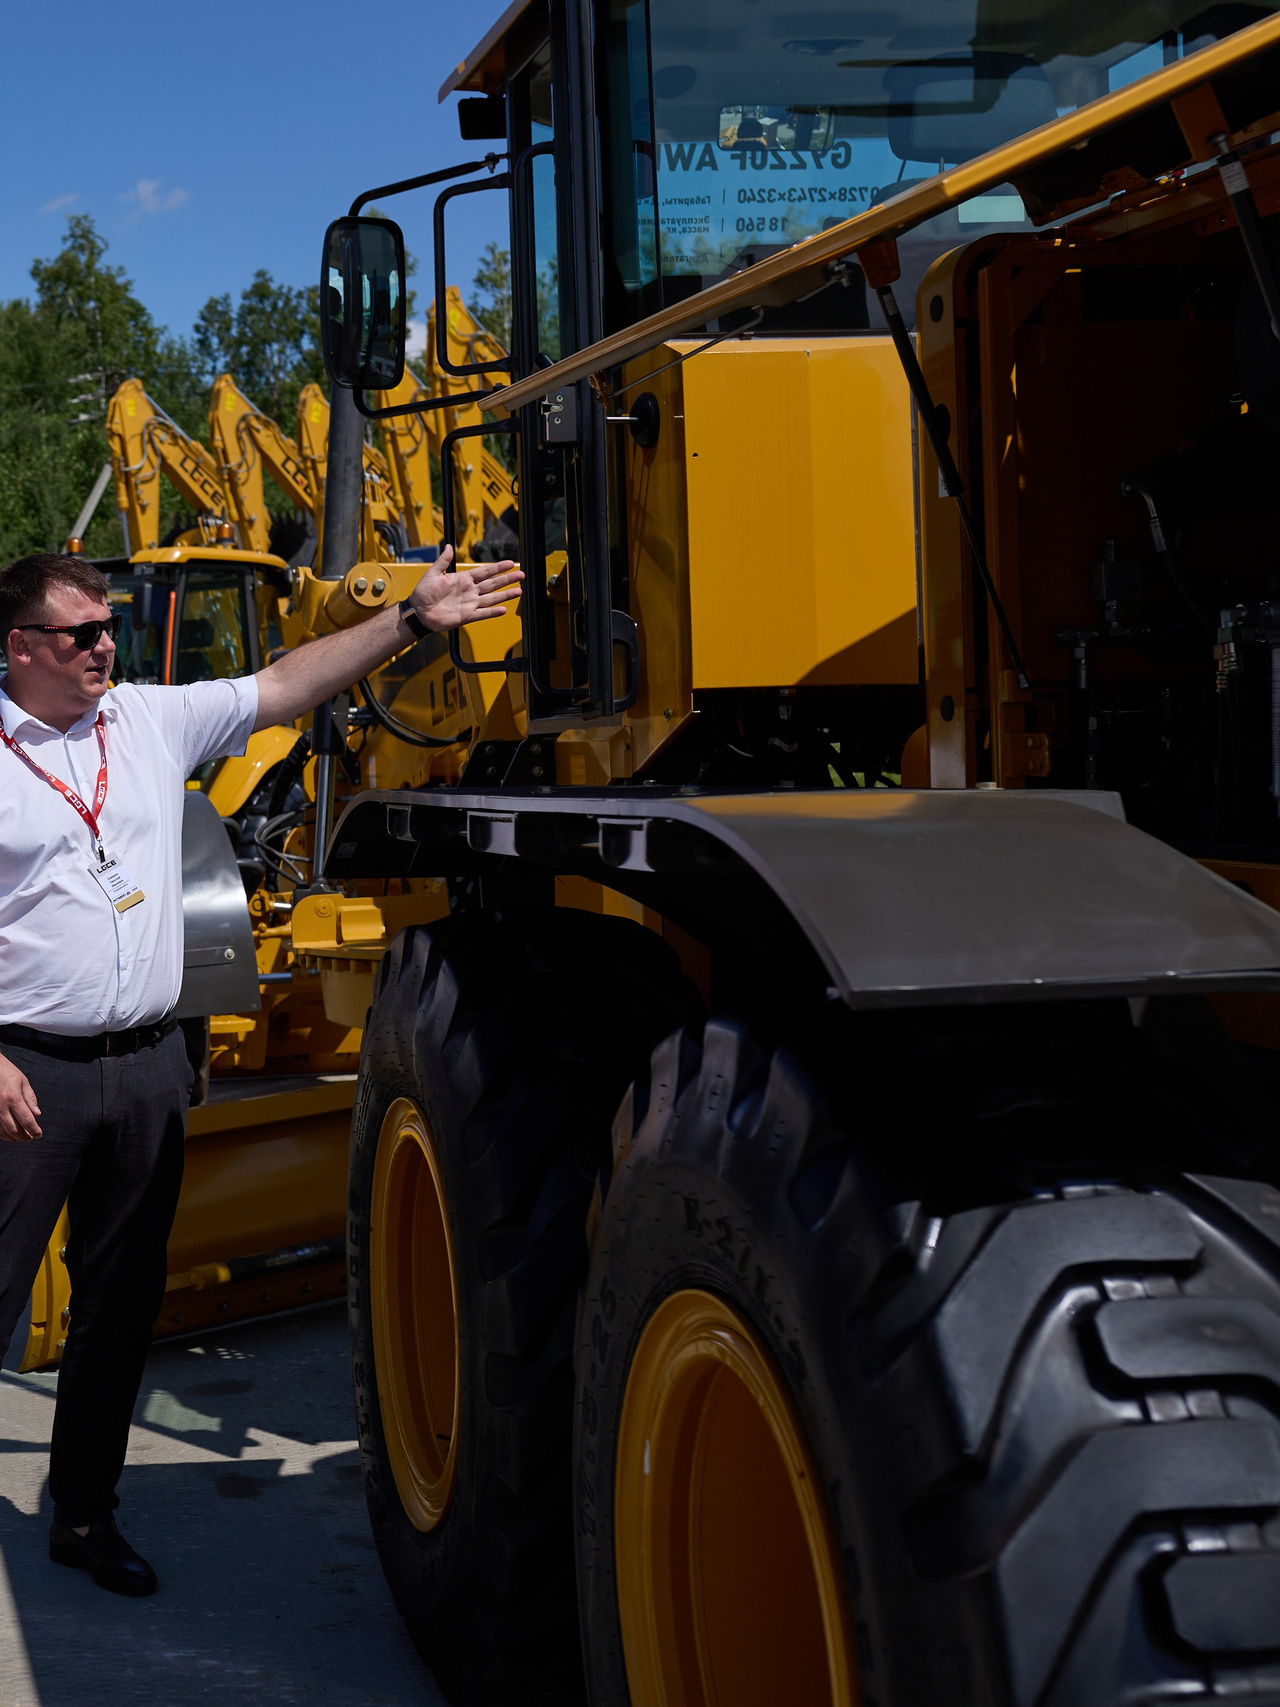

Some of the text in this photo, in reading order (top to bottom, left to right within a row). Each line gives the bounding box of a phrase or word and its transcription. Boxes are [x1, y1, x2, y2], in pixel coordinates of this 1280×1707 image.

[64, 788, 88, 815] LGCE
[96, 780, 106, 805] LGCE
[96, 859, 117, 874] LGCE
